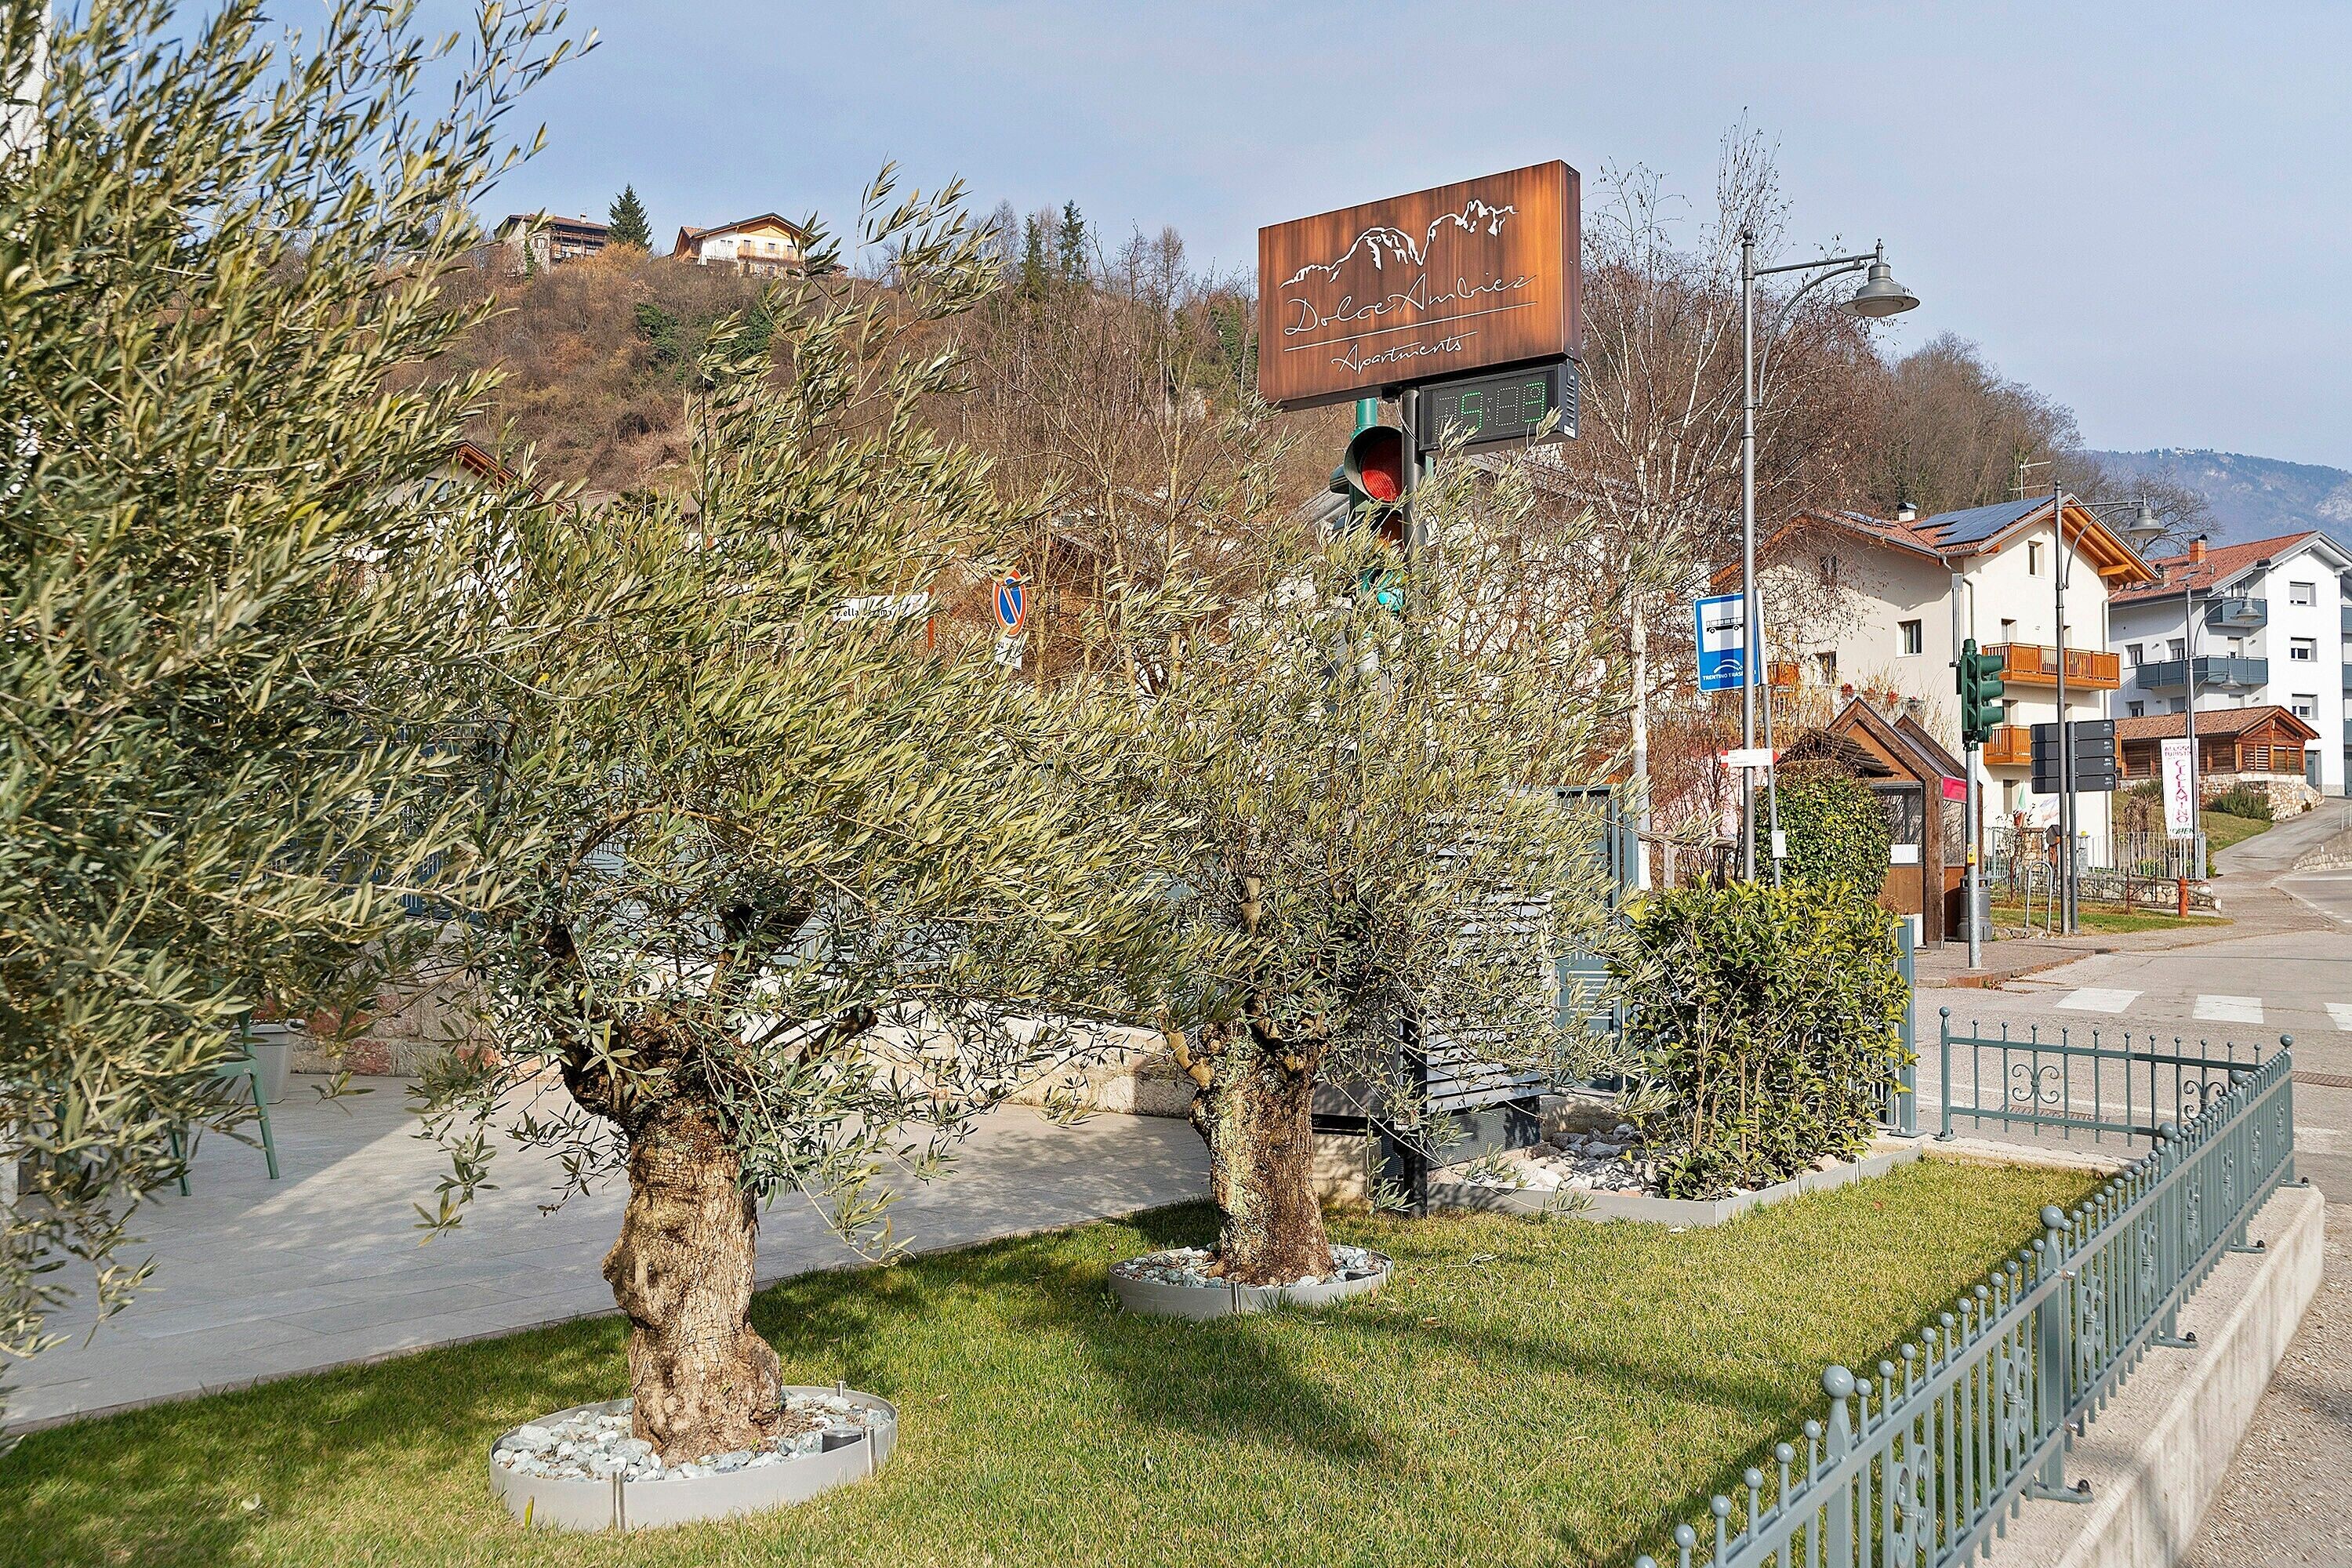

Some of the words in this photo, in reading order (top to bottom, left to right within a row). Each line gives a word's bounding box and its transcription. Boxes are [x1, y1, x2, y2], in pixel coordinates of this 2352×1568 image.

[1283, 295, 1396, 336] Dolce
[1387, 271, 1537, 314] Ambiez
[1330, 330, 1479, 376] Apartments
[2175, 759, 2189, 823] CICLAMINO
